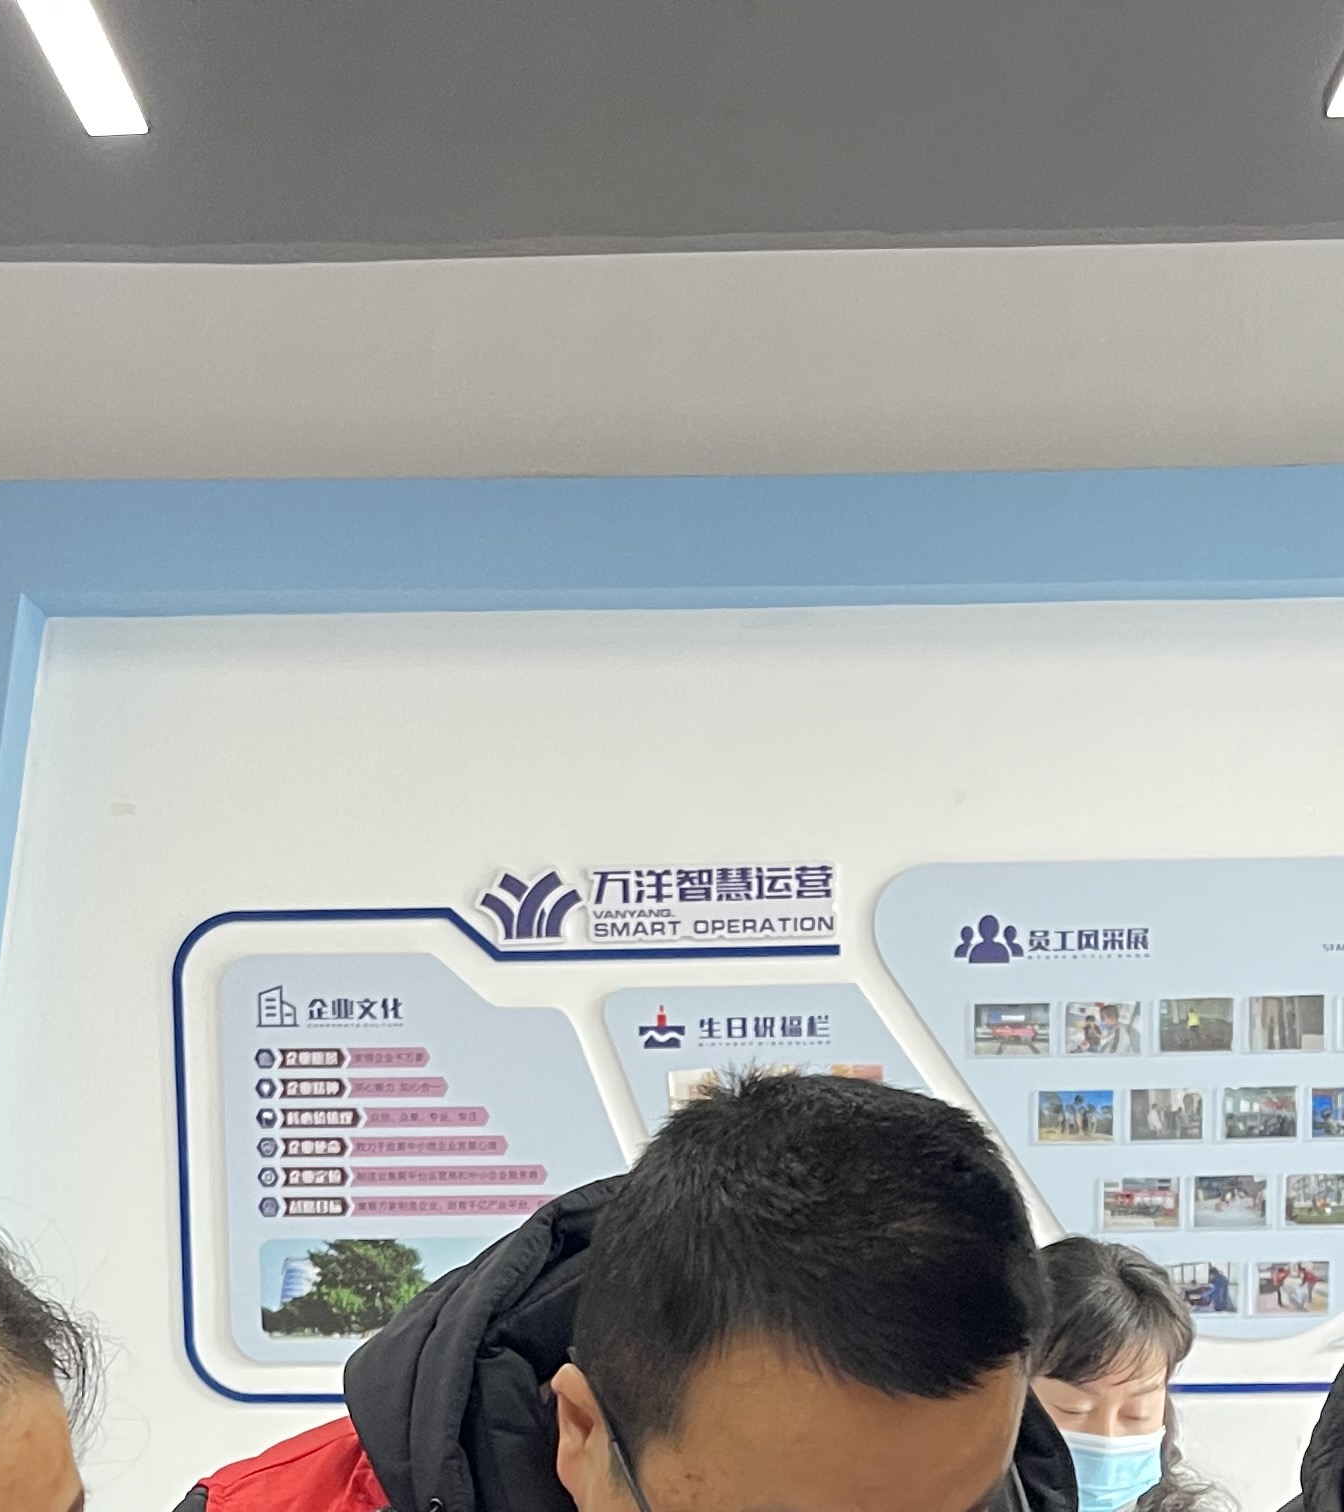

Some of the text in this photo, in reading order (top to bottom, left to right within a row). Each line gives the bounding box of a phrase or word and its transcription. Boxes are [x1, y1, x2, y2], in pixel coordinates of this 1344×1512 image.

[593, 865, 833, 905] 万洋智慧运营
[594, 916, 835, 937] SMART OPERATION
[1028, 928, 1150, 952] 员工风采展
[308, 997, 404, 1021] 企业文化
[699, 1014, 831, 1040] 生日祝福栏
